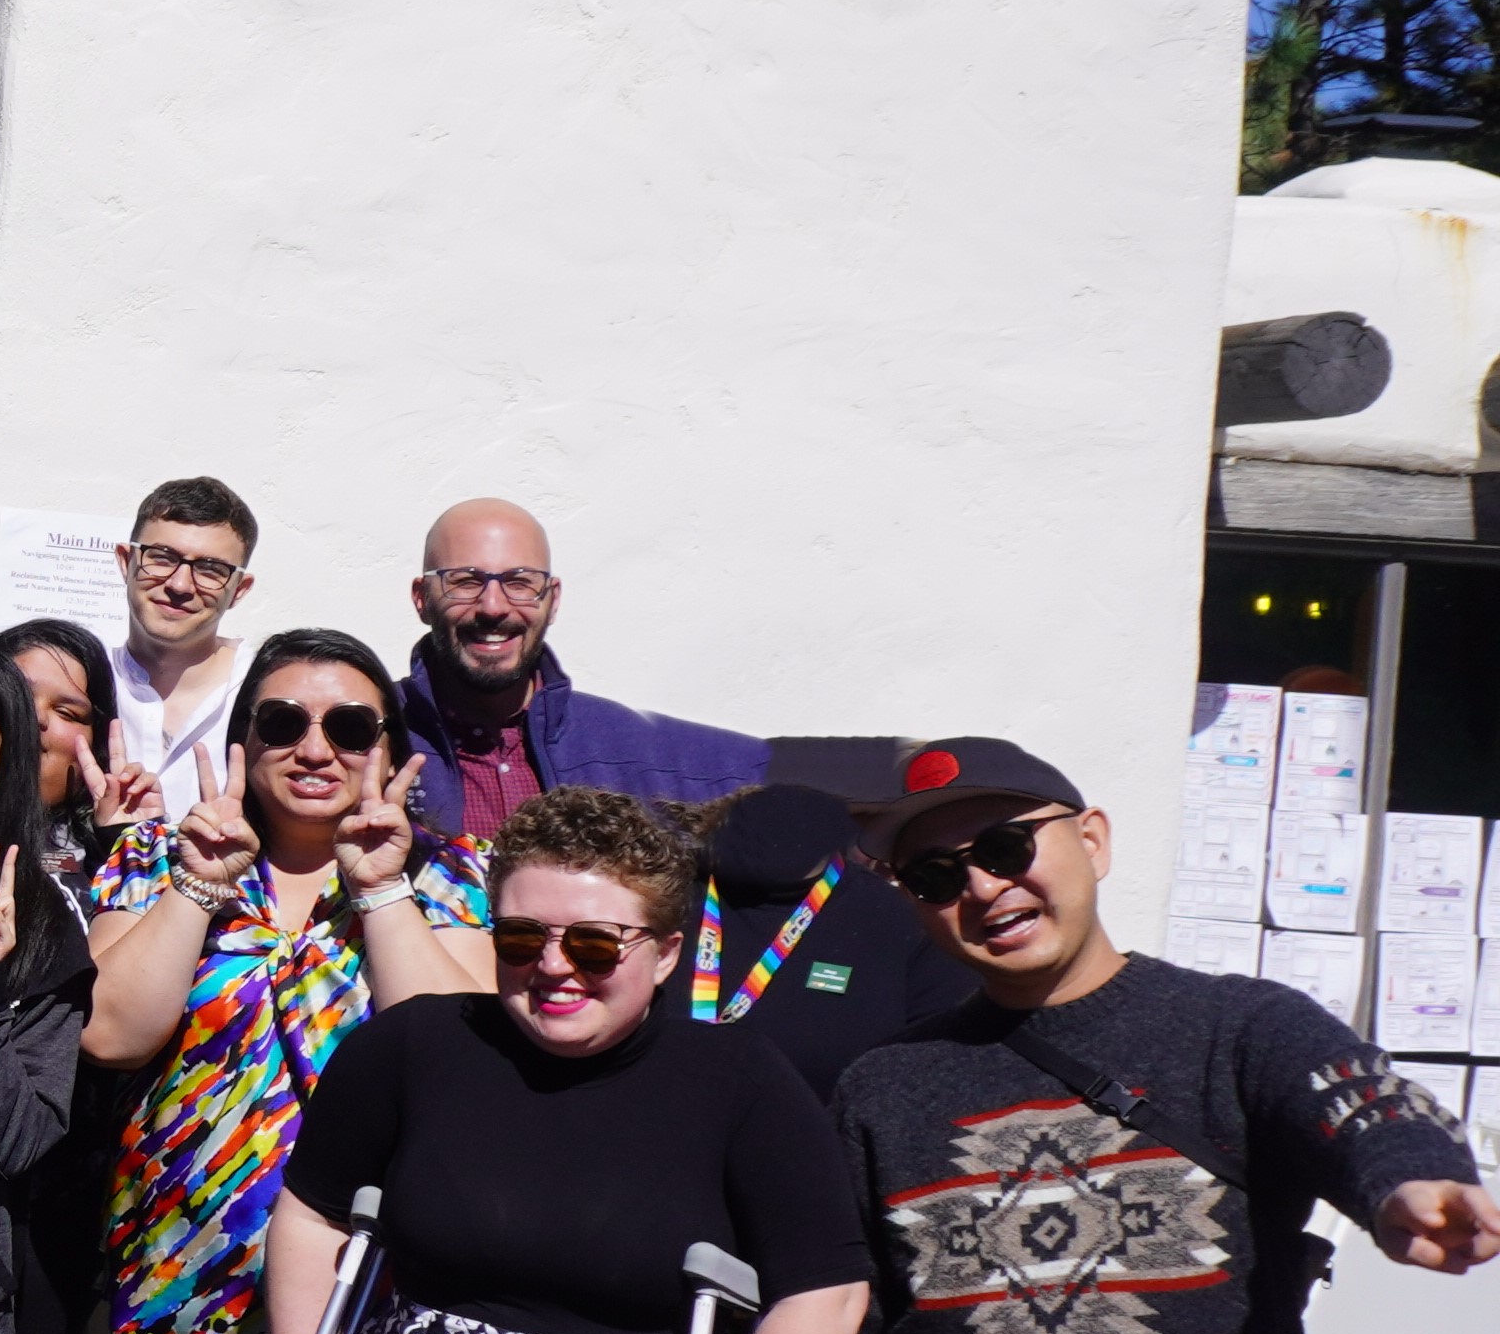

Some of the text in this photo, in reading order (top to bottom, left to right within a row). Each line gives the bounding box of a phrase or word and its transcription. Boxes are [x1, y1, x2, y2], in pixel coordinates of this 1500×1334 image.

[46, 532, 84, 547] Main
[700, 926, 717, 972] UCCS
[781, 905, 814, 949] UCCS
